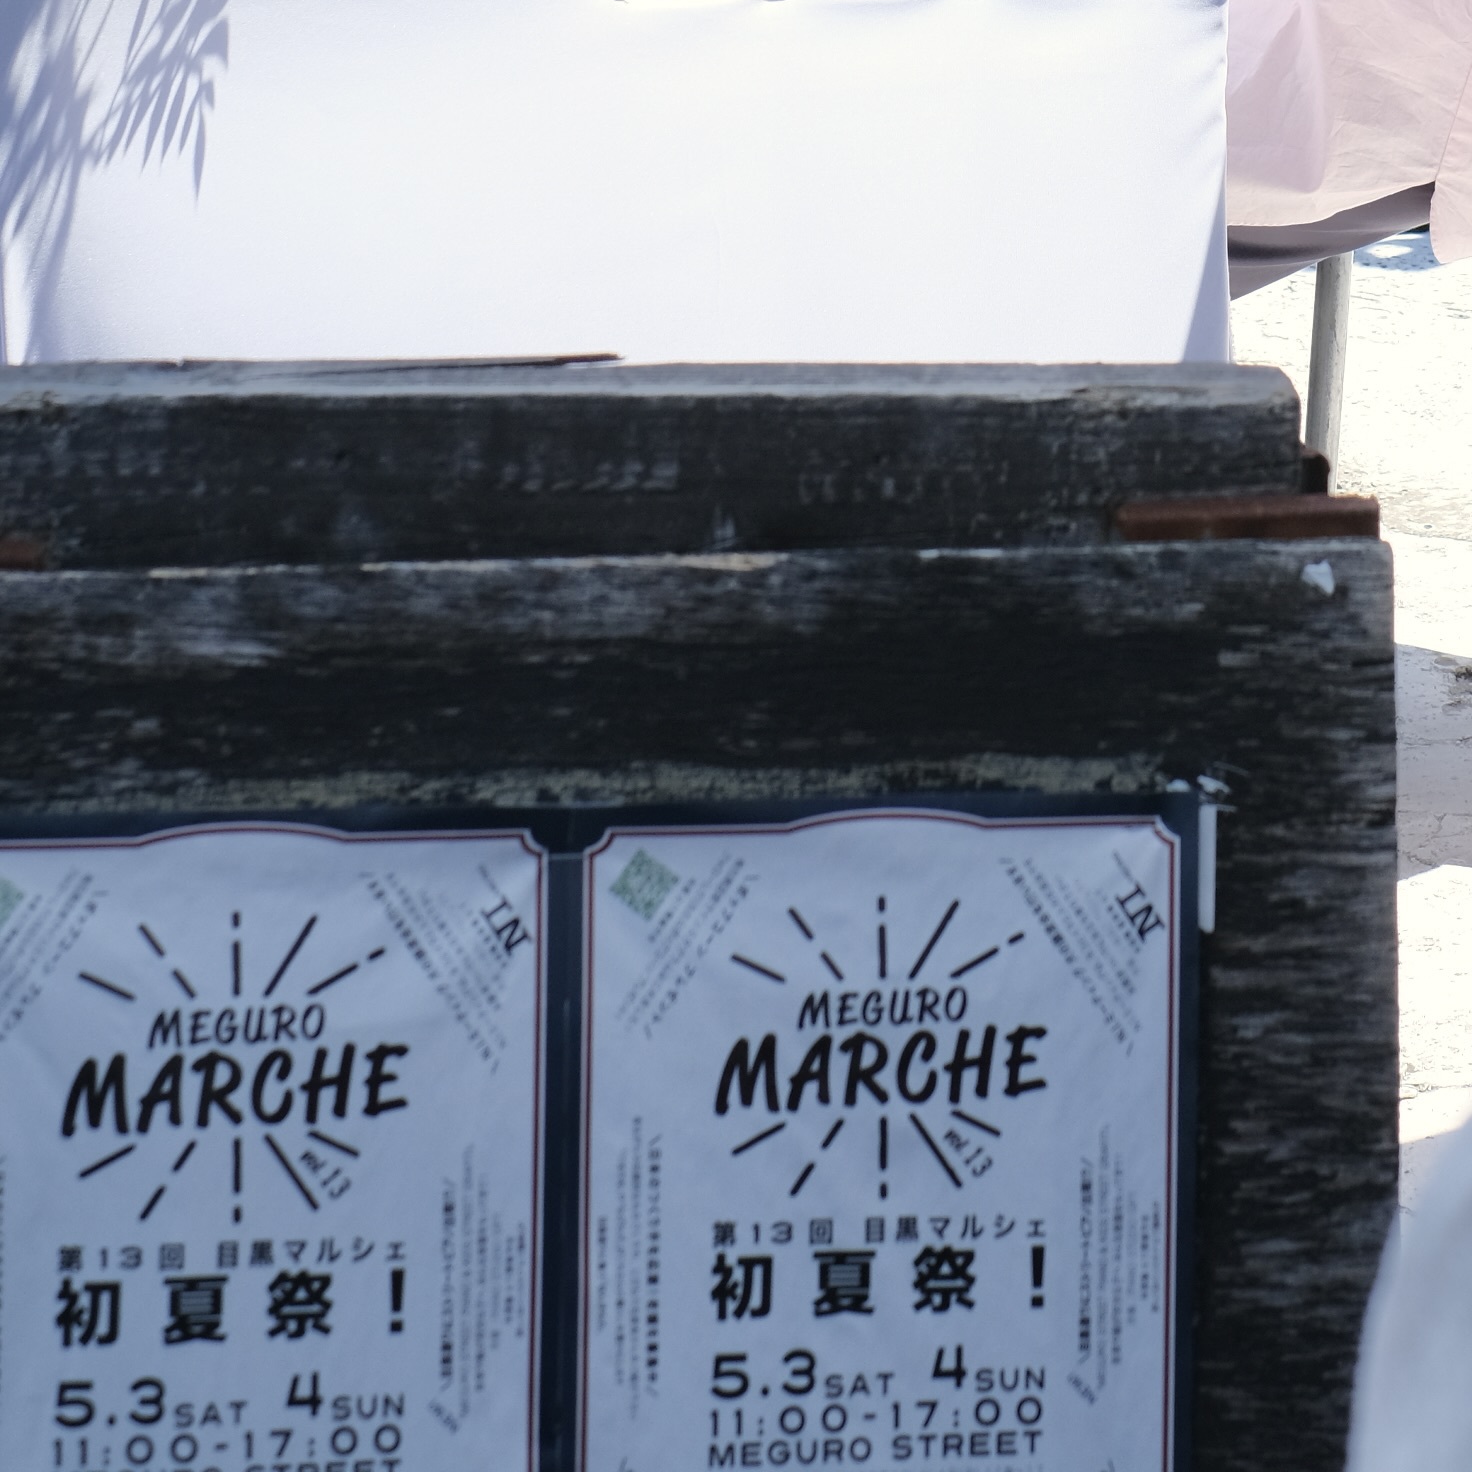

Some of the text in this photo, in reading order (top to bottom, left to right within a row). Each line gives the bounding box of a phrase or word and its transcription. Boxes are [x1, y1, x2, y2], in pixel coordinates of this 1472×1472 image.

[148, 1004, 327, 1050] MEGURO
[798, 986, 969, 1031] MEGURO
[60, 1043, 410, 1137] MARCHE
[714, 1025, 1049, 1116] MARCHE
[708, 1430, 1043, 1468] MEGURO STREET
